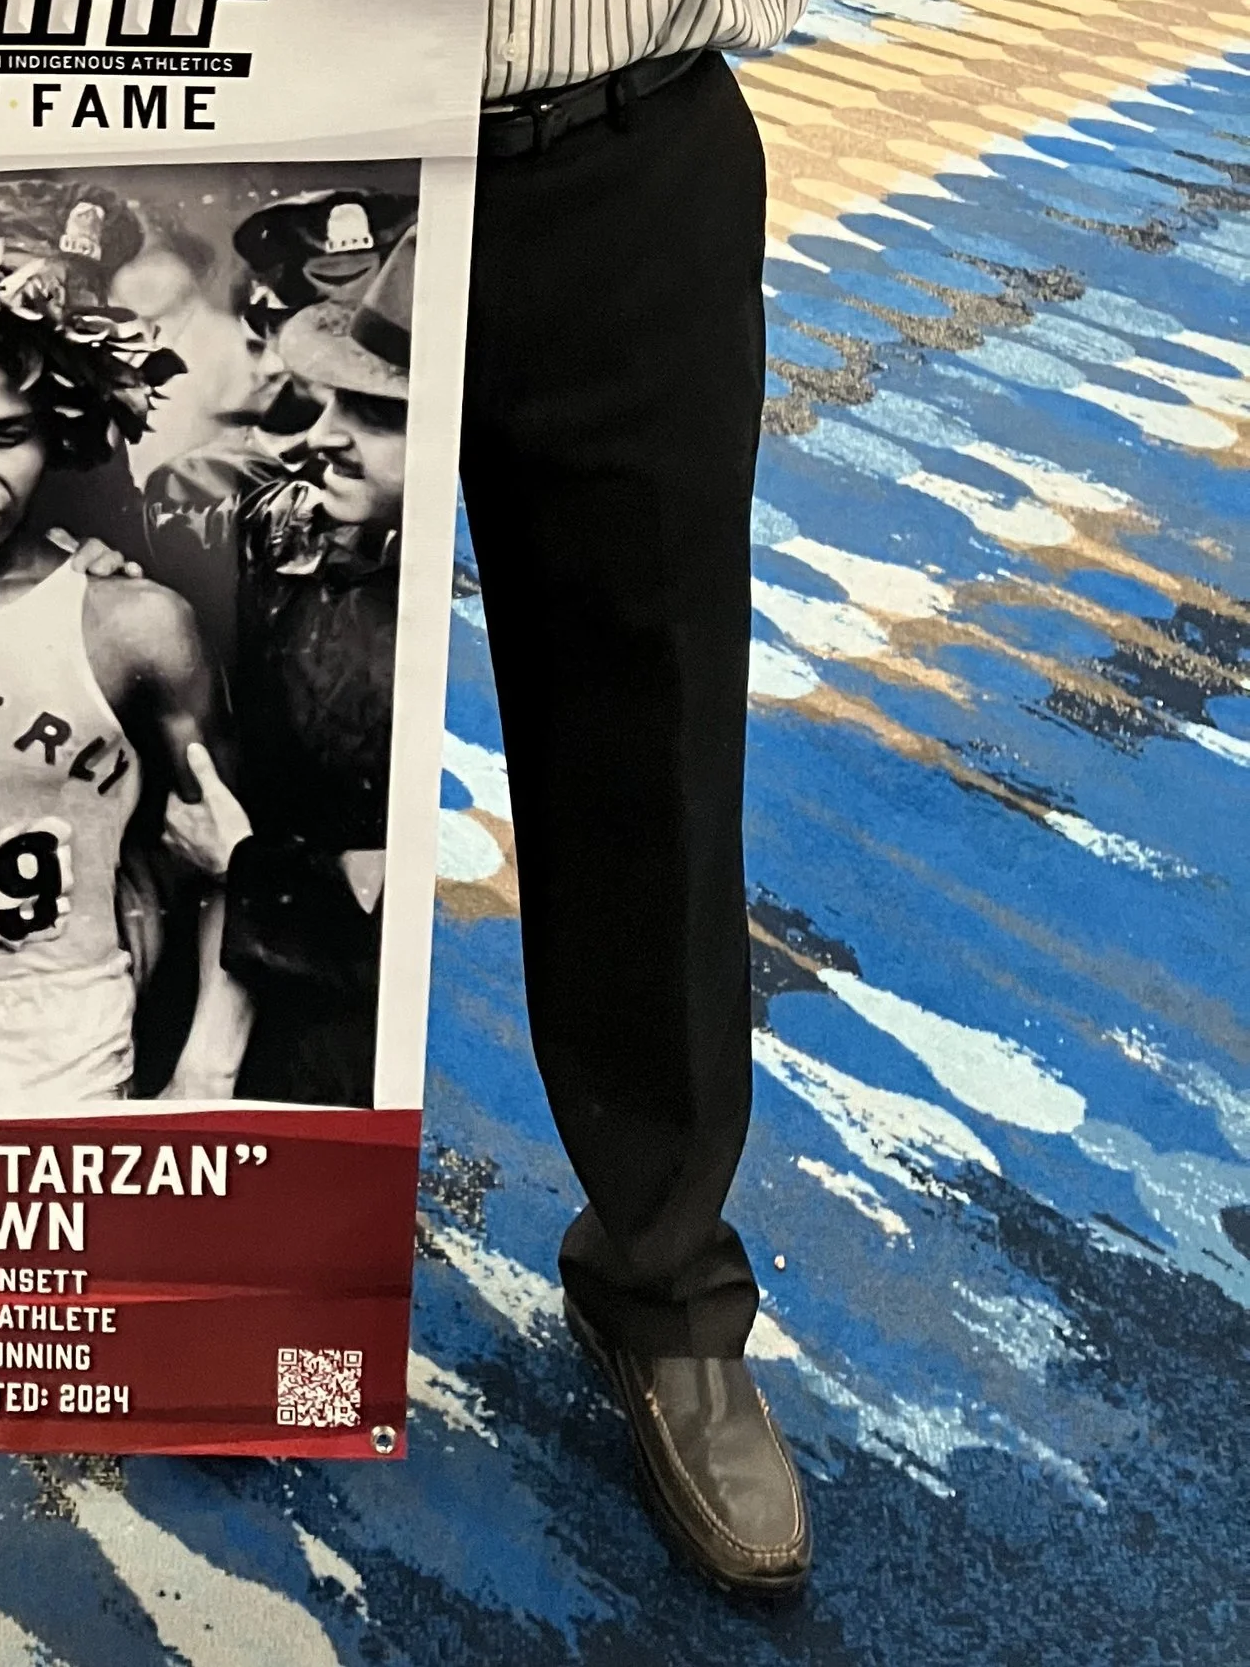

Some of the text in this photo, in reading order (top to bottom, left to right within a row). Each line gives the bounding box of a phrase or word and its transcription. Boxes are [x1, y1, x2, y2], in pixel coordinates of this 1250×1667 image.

[8, 55, 126, 71] INDIGENOUS
[131, 56, 234, 72] ATHLETICS
[32, 83, 216, 130] FAME
[59, 1384, 129, 1414] 2024
